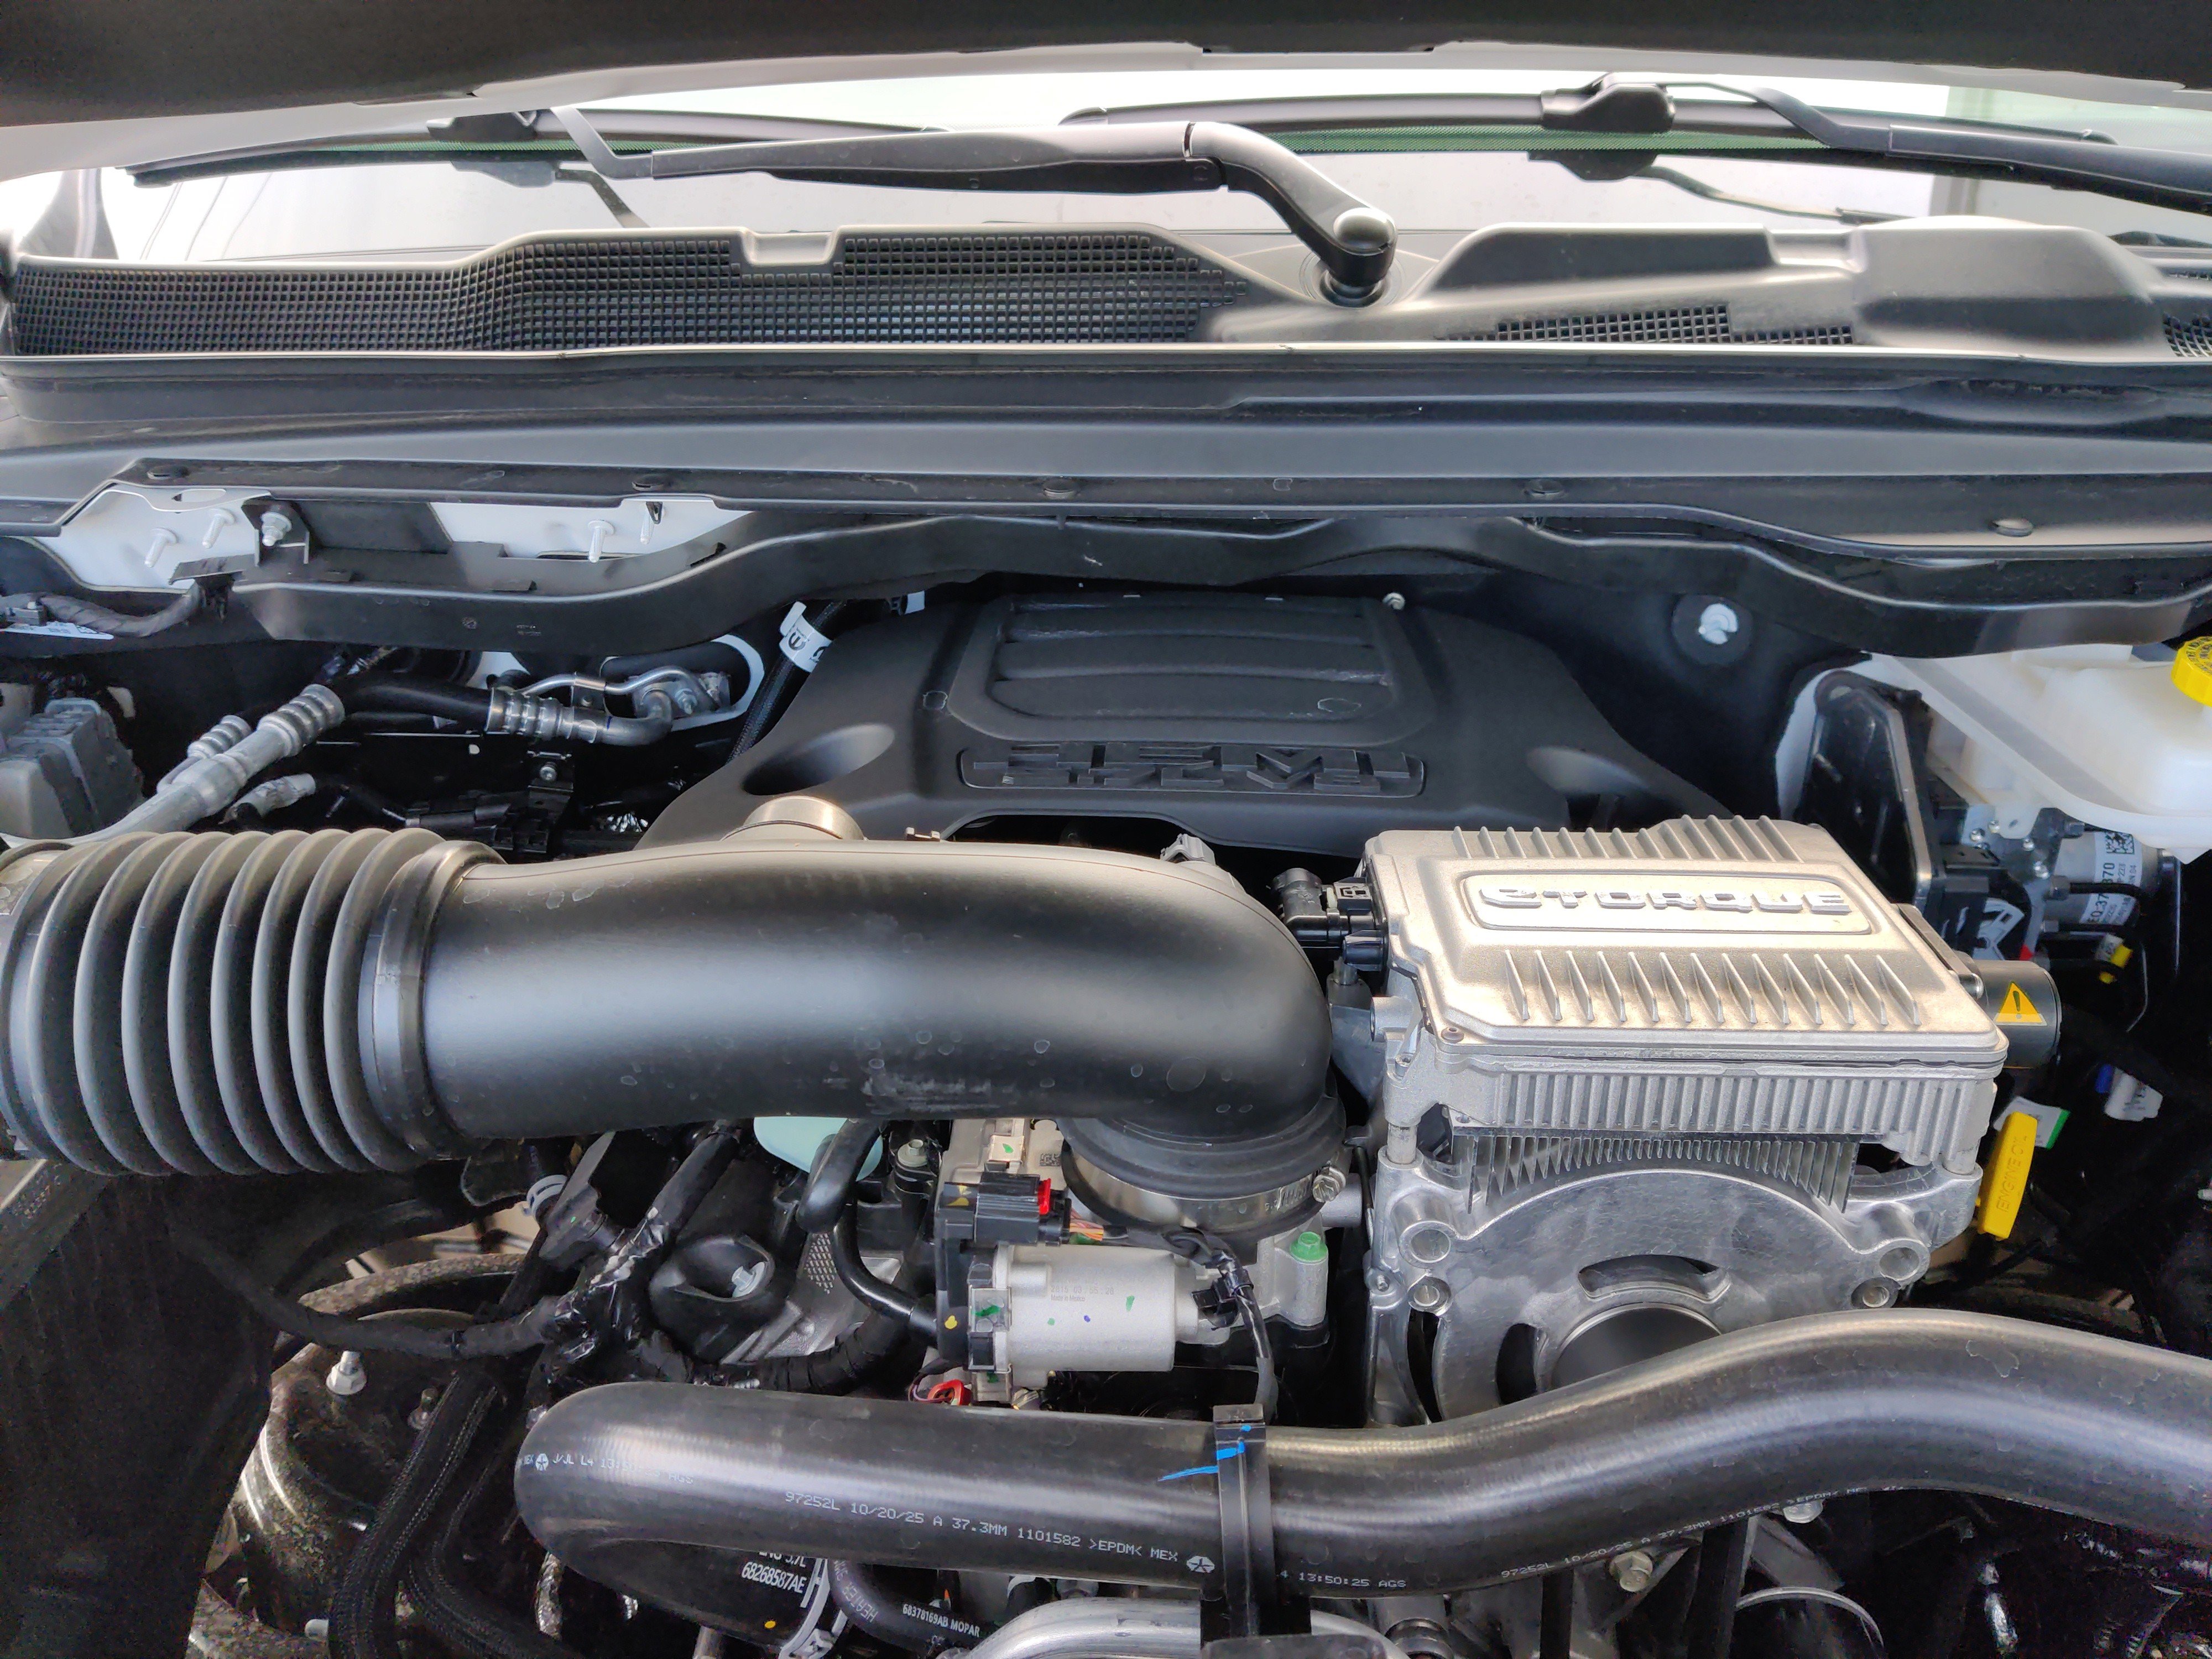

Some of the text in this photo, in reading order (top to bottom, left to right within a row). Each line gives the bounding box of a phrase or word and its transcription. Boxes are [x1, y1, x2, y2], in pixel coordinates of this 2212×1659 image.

[785, 1491, 1178, 1562] 97252L 10/20/25 A 37.3MM 1101582 >EPDM< MEX
[741, 1561, 807, 1594] 68268587AE
[1500, 1562, 1555, 1578] 97252L
[1564, 1541, 1633, 1564] 10/20/25
[1299, 1572, 1370, 1587] 13:50:25
[1378, 1579, 1407, 1588] AGS
[842, 1582, 879, 1623] HEATER
[902, 1603, 981, 1638] 68378169AB MOPAR
